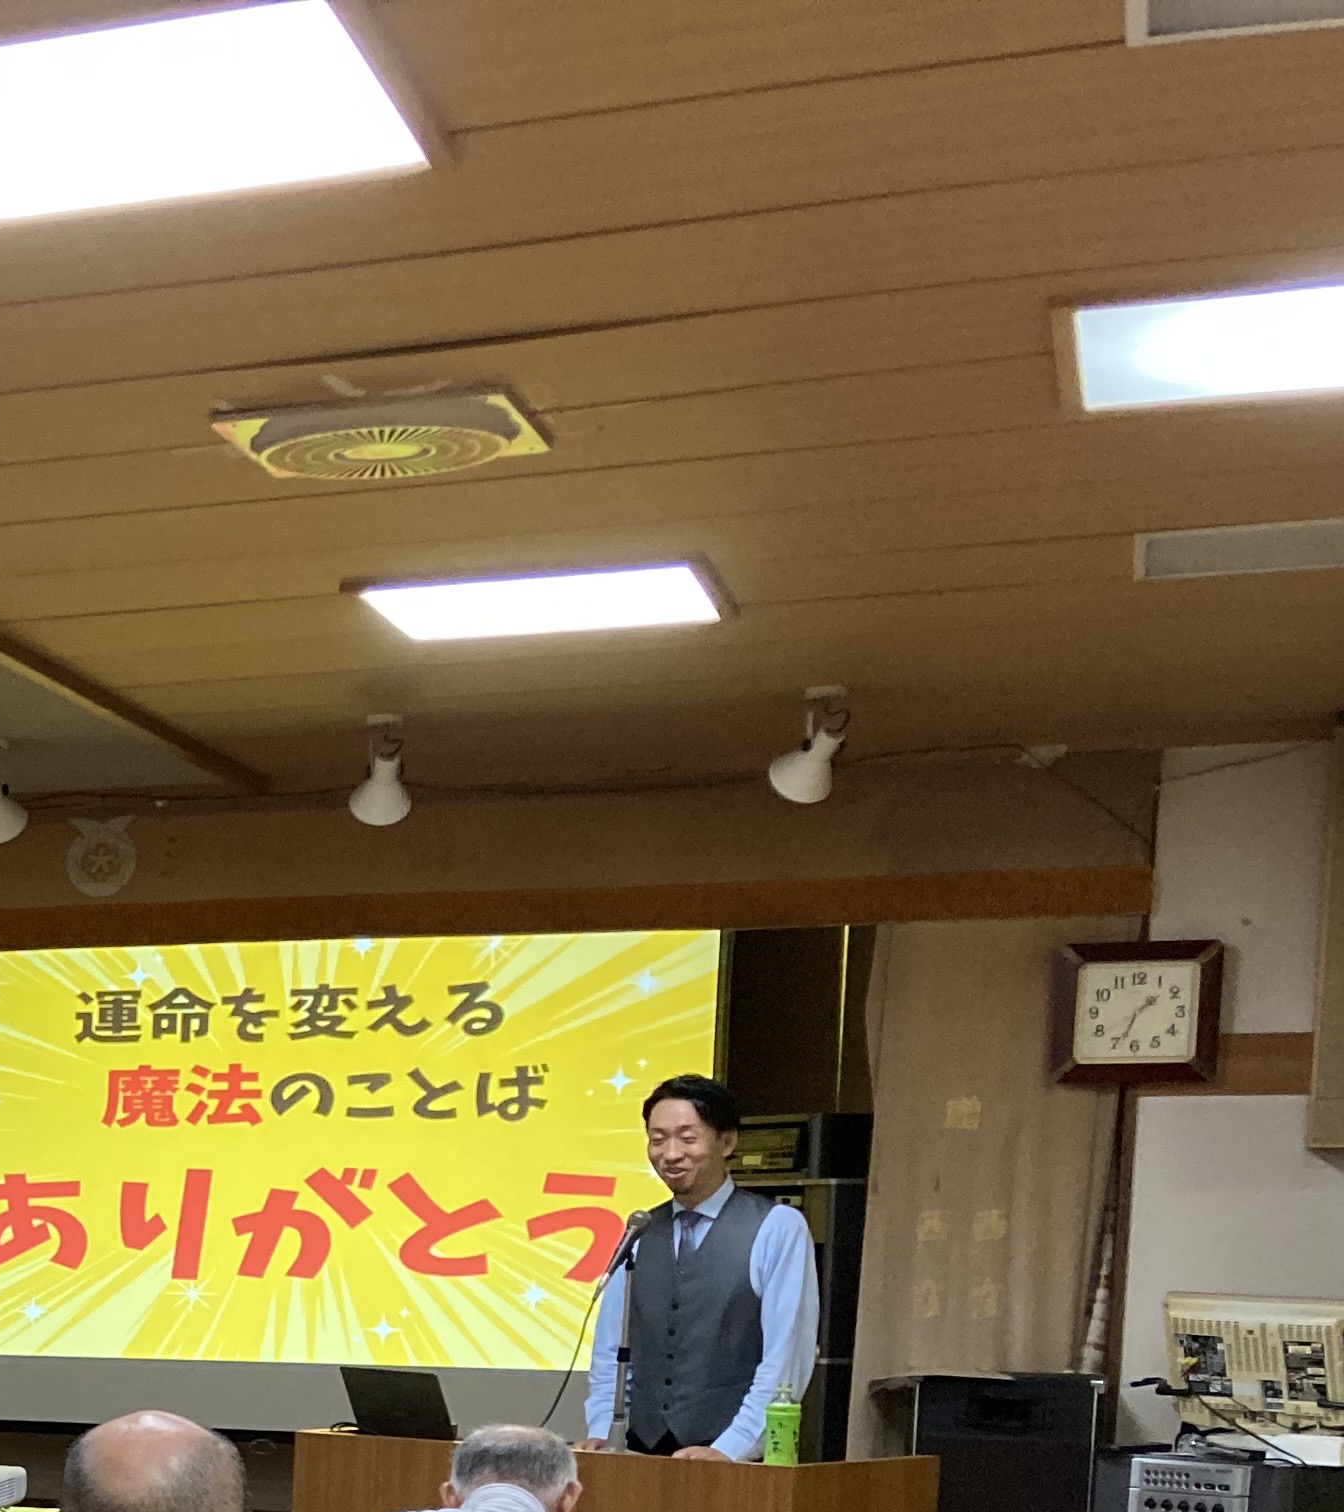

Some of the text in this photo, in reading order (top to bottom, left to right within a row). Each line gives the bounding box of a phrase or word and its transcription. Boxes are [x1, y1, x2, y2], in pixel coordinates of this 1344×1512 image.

[1113, 975, 1126, 989] 11
[1131, 972, 1148, 985] 12
[1095, 988, 1111, 1002] 10
[1169, 987, 1181, 1000] 2
[75, 981, 507, 1045] 運命を変える
[1089, 1007, 1099, 1019] 9
[1175, 1006, 1186, 1018] 3
[1094, 1024, 1105, 1037] 8
[1166, 1023, 1178, 1037] 4
[1109, 1037, 1121, 1050] 7
[1129, 1040, 1140, 1053] 6
[1149, 1036, 1161, 1049] 5
[101, 1063, 551, 1128] 魔法のことば
